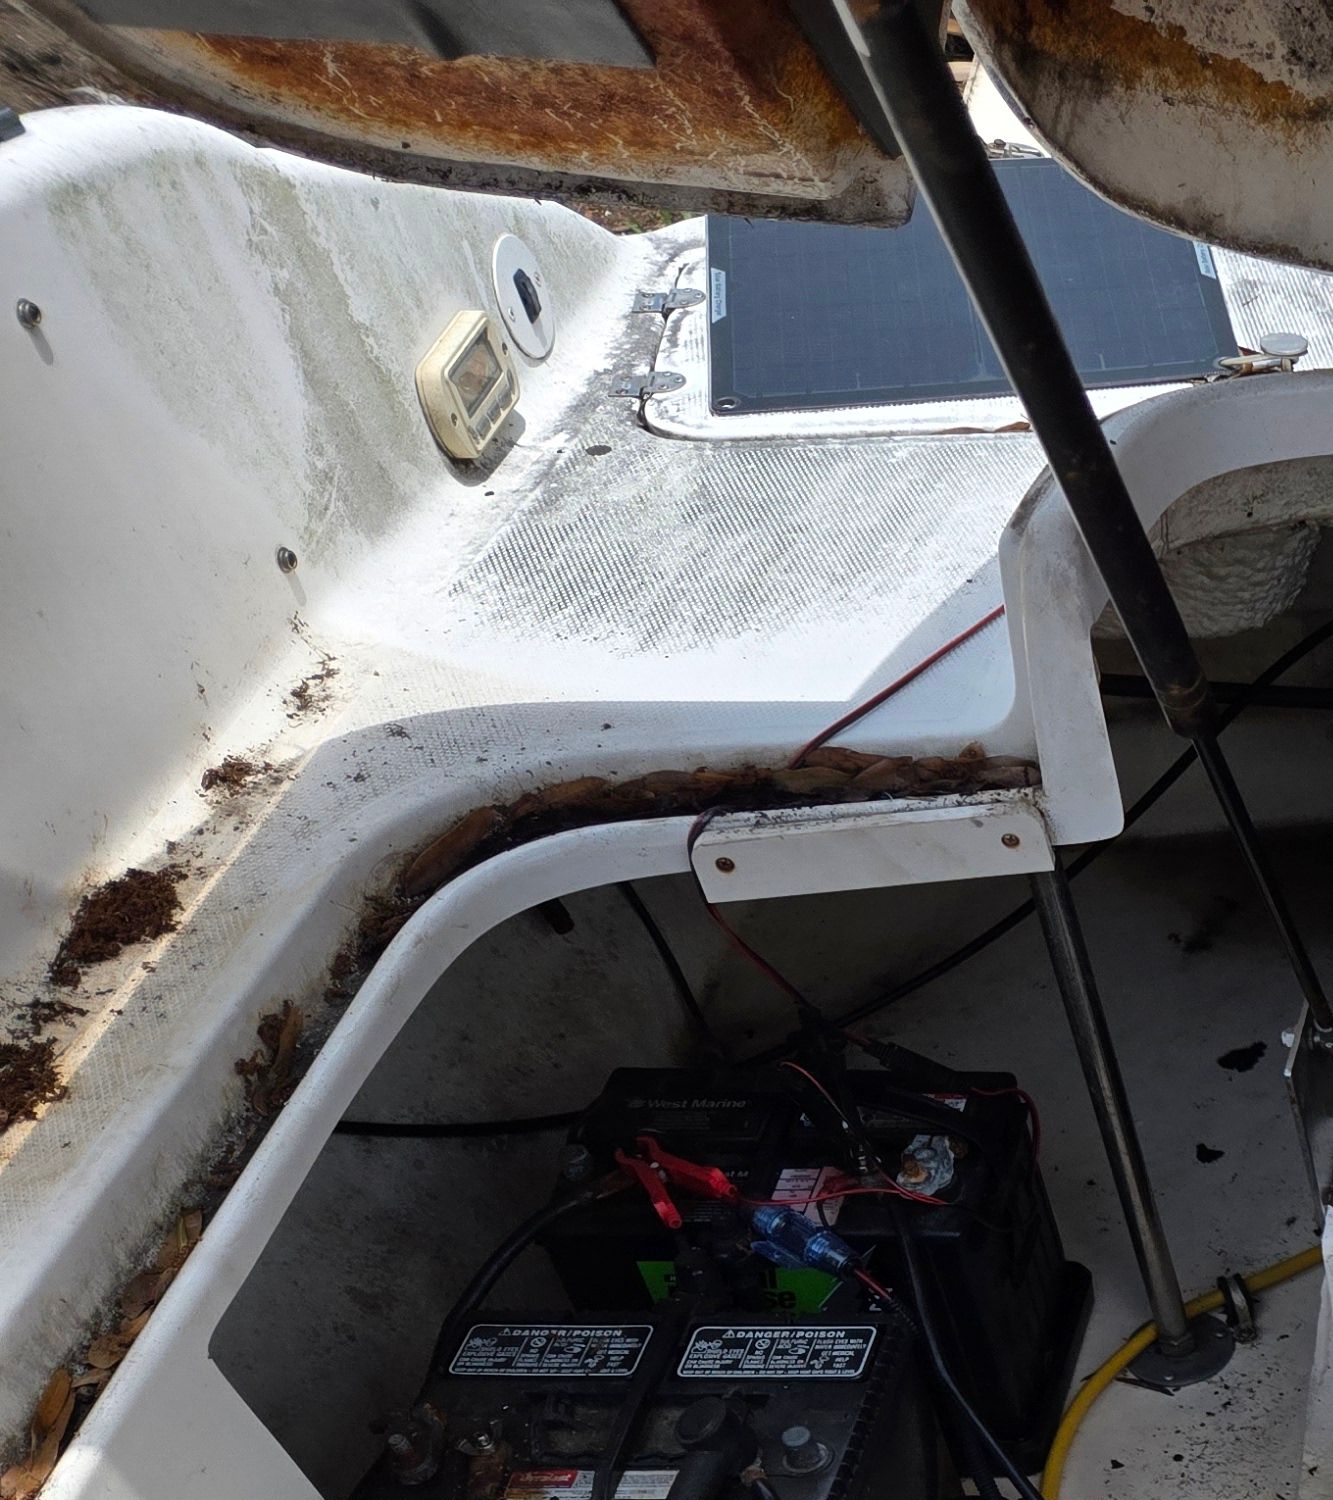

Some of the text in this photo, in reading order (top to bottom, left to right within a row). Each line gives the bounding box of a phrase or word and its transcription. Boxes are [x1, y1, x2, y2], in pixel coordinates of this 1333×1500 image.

[648, 1097, 747, 1109] West Marine
[735, 1331, 846, 1340] DANGER/POISON
